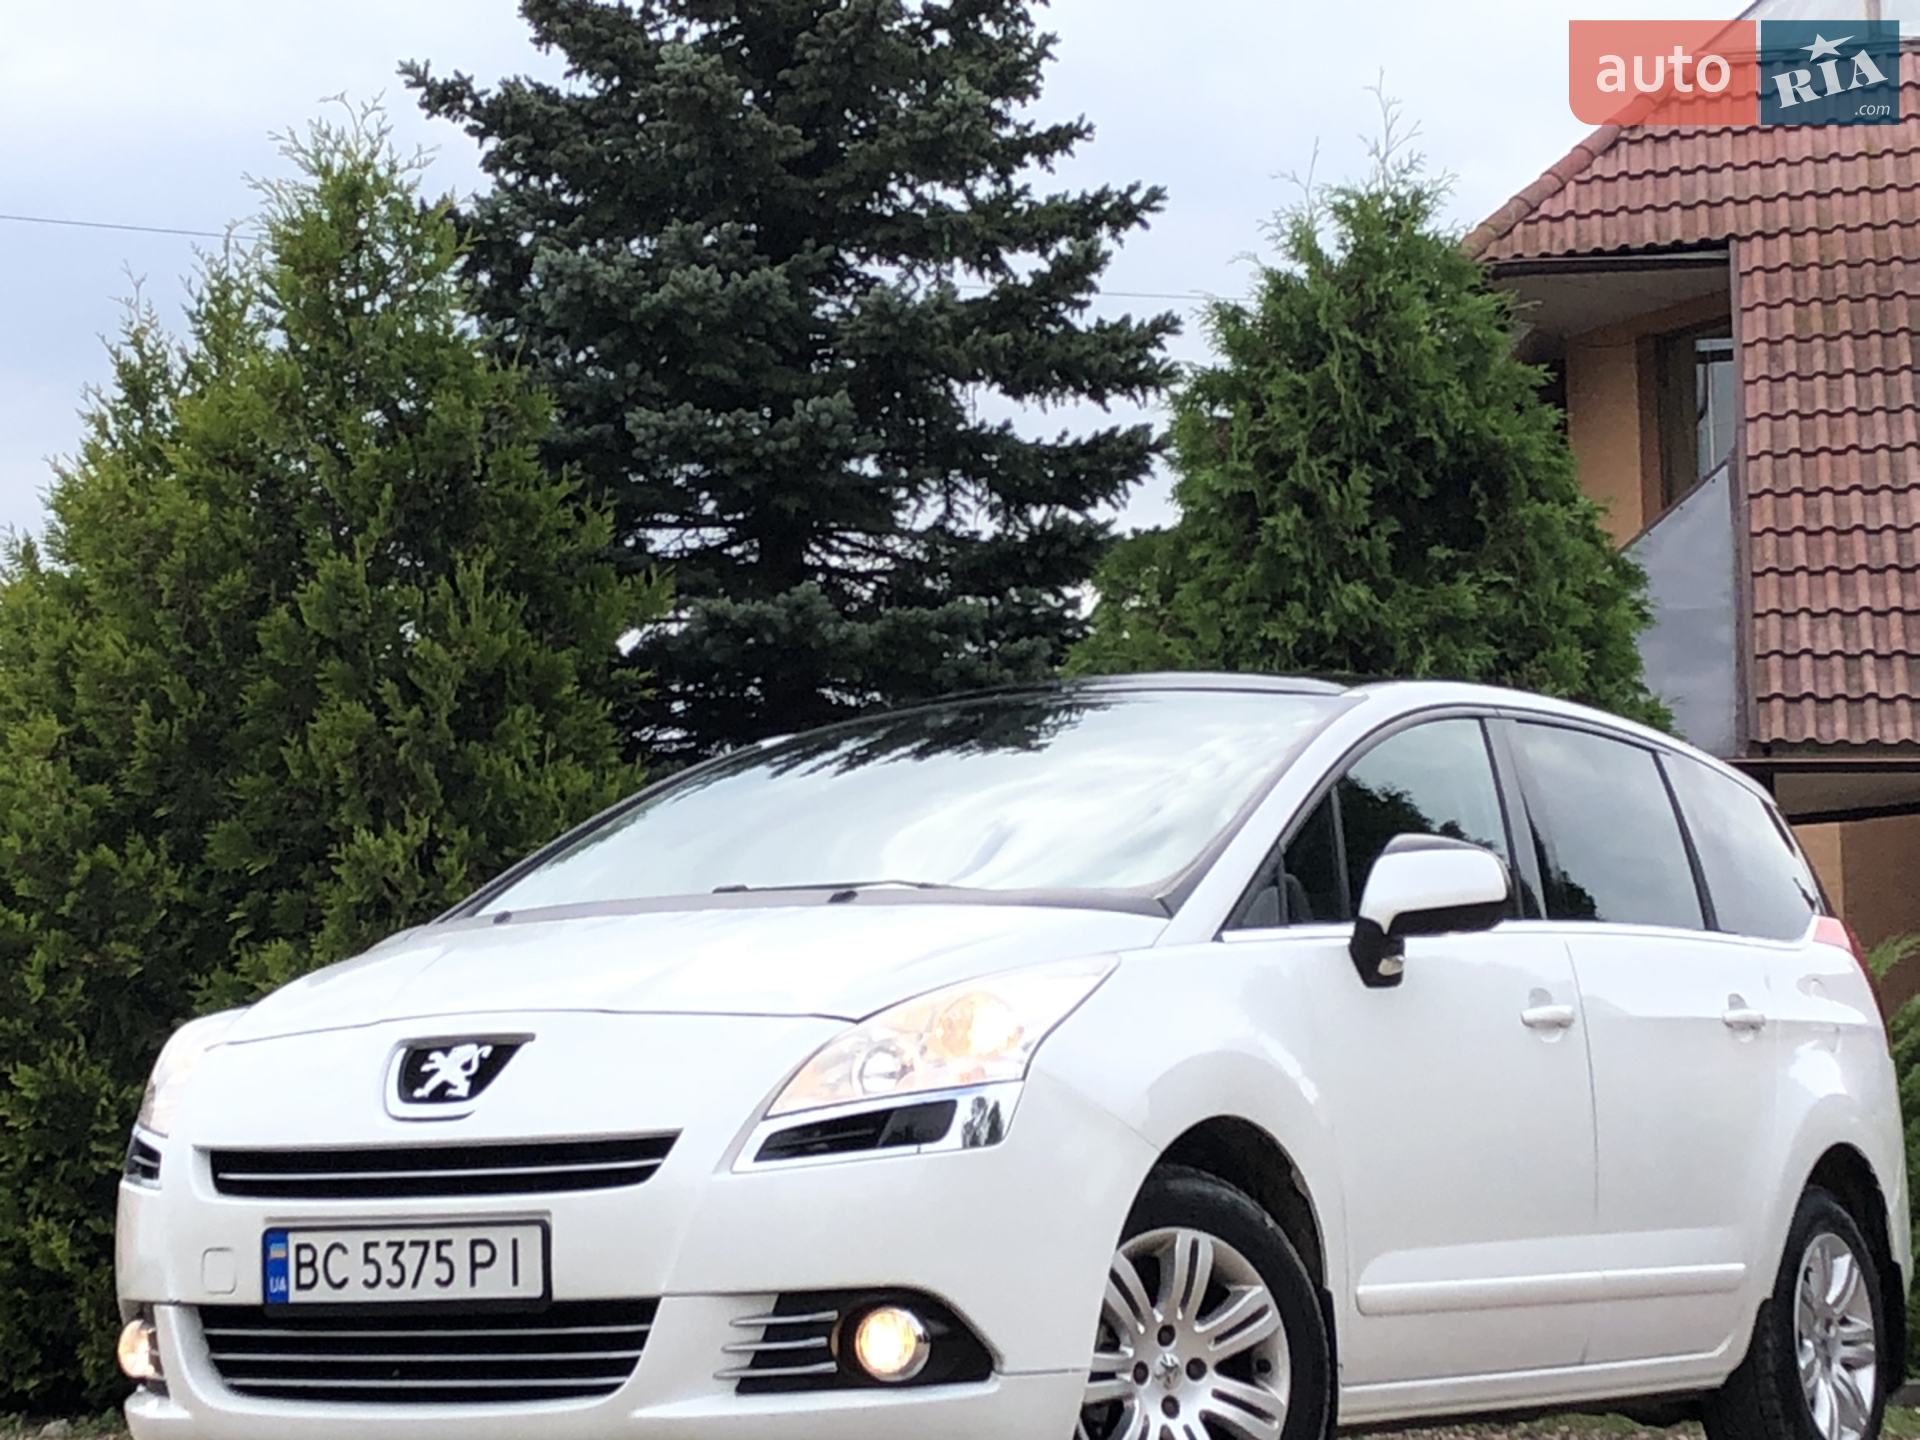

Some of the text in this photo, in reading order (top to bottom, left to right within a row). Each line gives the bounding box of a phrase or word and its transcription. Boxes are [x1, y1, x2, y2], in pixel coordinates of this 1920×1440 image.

[295, 1242, 349, 1291] BC
[362, 1239, 455, 1289] 5375
[269, 1275, 287, 1293] UA
